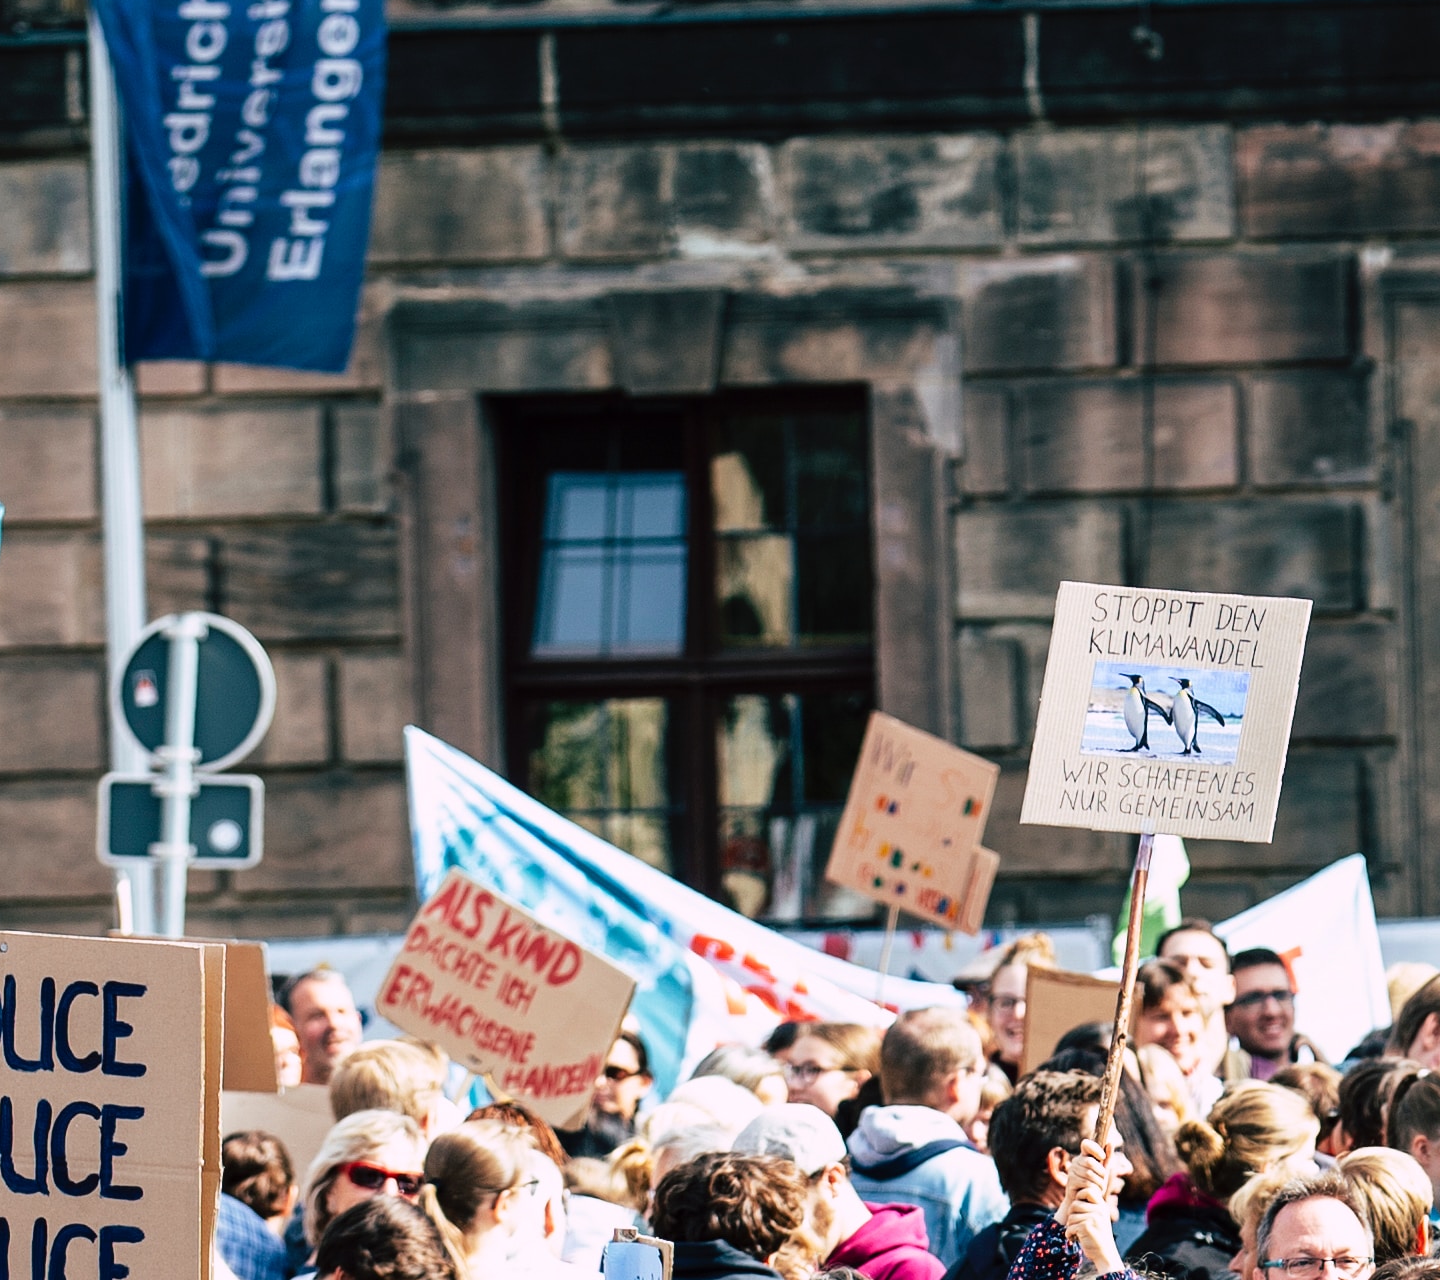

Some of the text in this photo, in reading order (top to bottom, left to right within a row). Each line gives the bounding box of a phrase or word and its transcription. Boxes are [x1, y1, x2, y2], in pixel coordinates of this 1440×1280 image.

[1091, 593, 1267, 632] STOPPT DEN
[1088, 627, 1264, 668] KLIMAWANDEL
[1062, 759, 1256, 796] WIR SCHAFFEN ES
[1059, 789, 1255, 823] NUR GEMEINSAM
[423, 880, 495, 939] ALS
[404, 923, 538, 1017] DACHTE ICH
[382, 964, 536, 1064] ERWACHSENE
